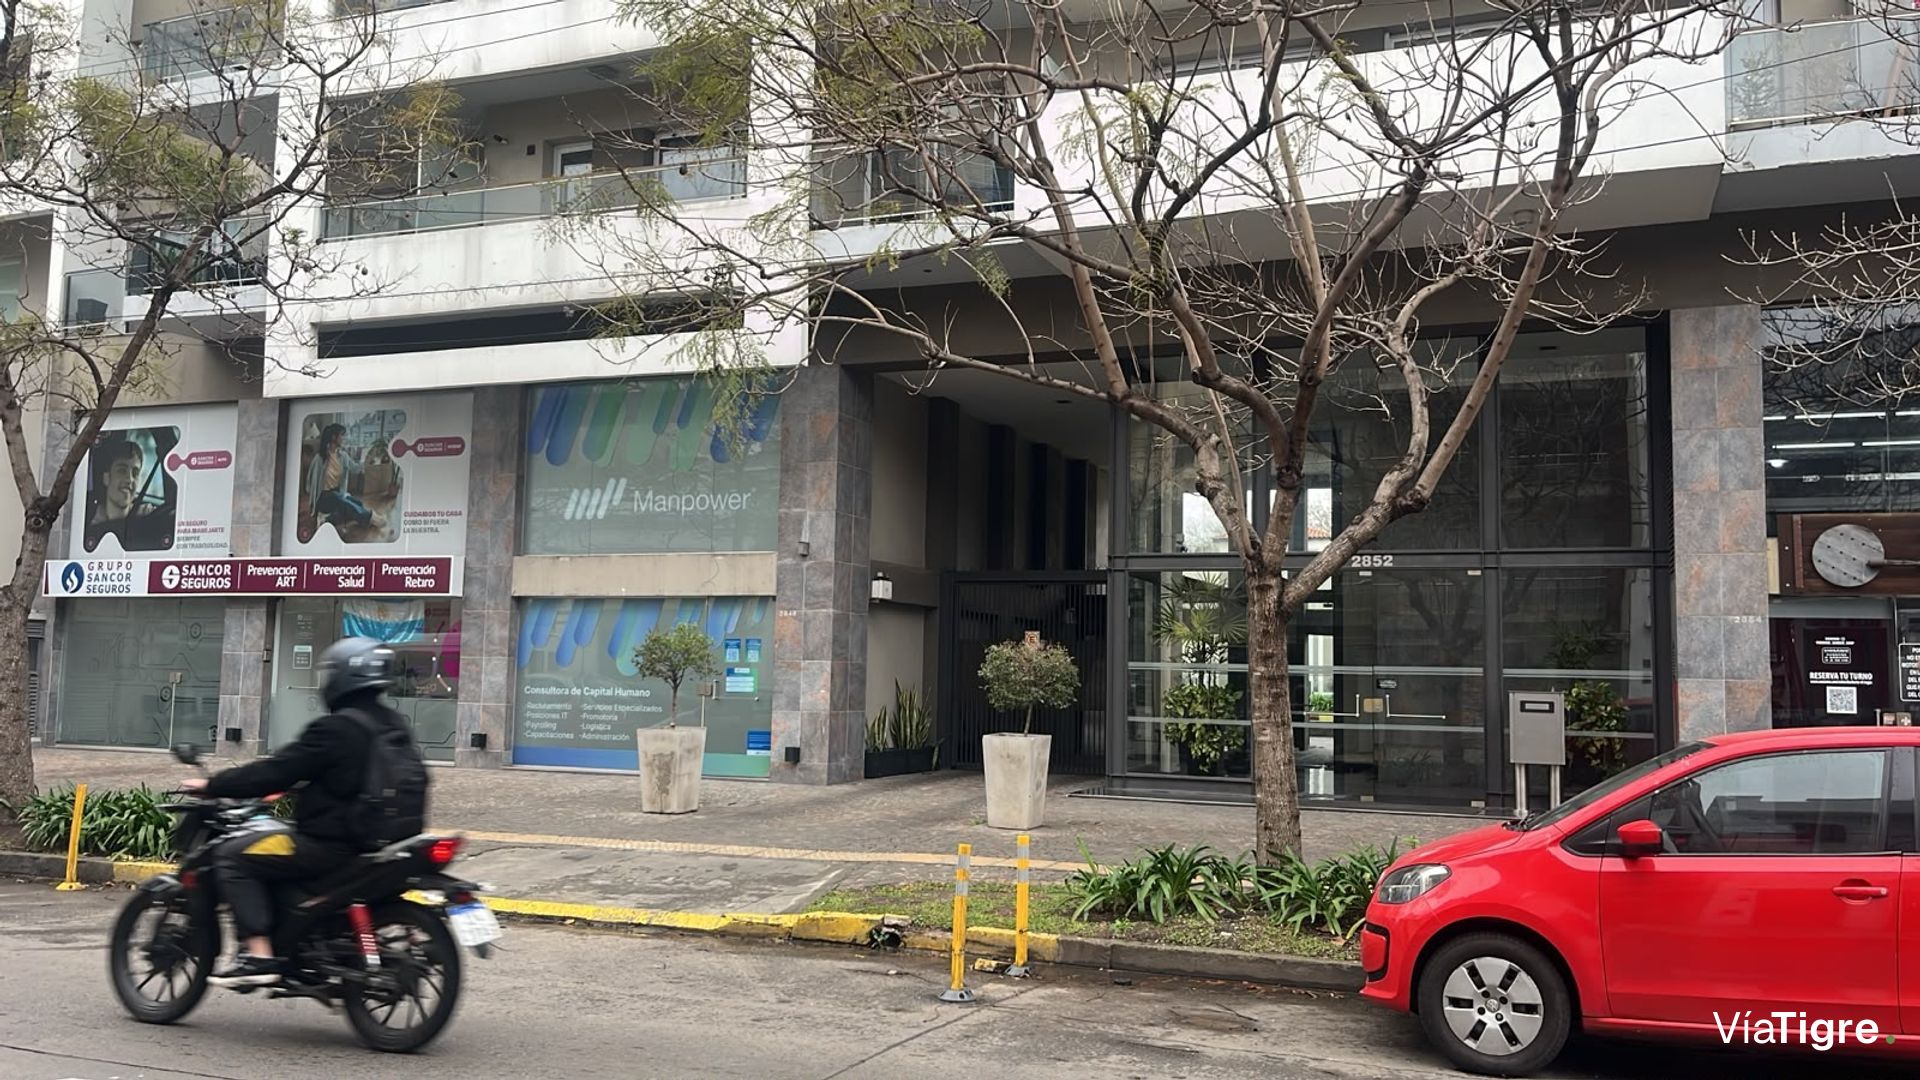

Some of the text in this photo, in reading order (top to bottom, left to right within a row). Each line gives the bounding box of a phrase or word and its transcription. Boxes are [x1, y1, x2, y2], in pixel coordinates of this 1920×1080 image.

[633, 490, 751, 517] Manpower
[87, 561, 133, 571] GRUPO
[1351, 555, 1393, 567] 2852
[181, 564, 232, 576] SANCOR
[247, 564, 298, 576] Prevención
[313, 563, 365, 576] Prevención
[381, 563, 436, 576] Prevención
[87, 573, 131, 583] SANCOR
[181, 577, 232, 589] SEGUROS
[276, 576, 298, 588] ART
[338, 576, 365, 588] Salud
[405, 576, 435, 588] Retiro
[86, 584, 131, 594] SEGUROS
[1809, 671, 1873, 681] RESERVA TU TURNO
[524, 686, 651, 698] Consultora de Capital Humano
